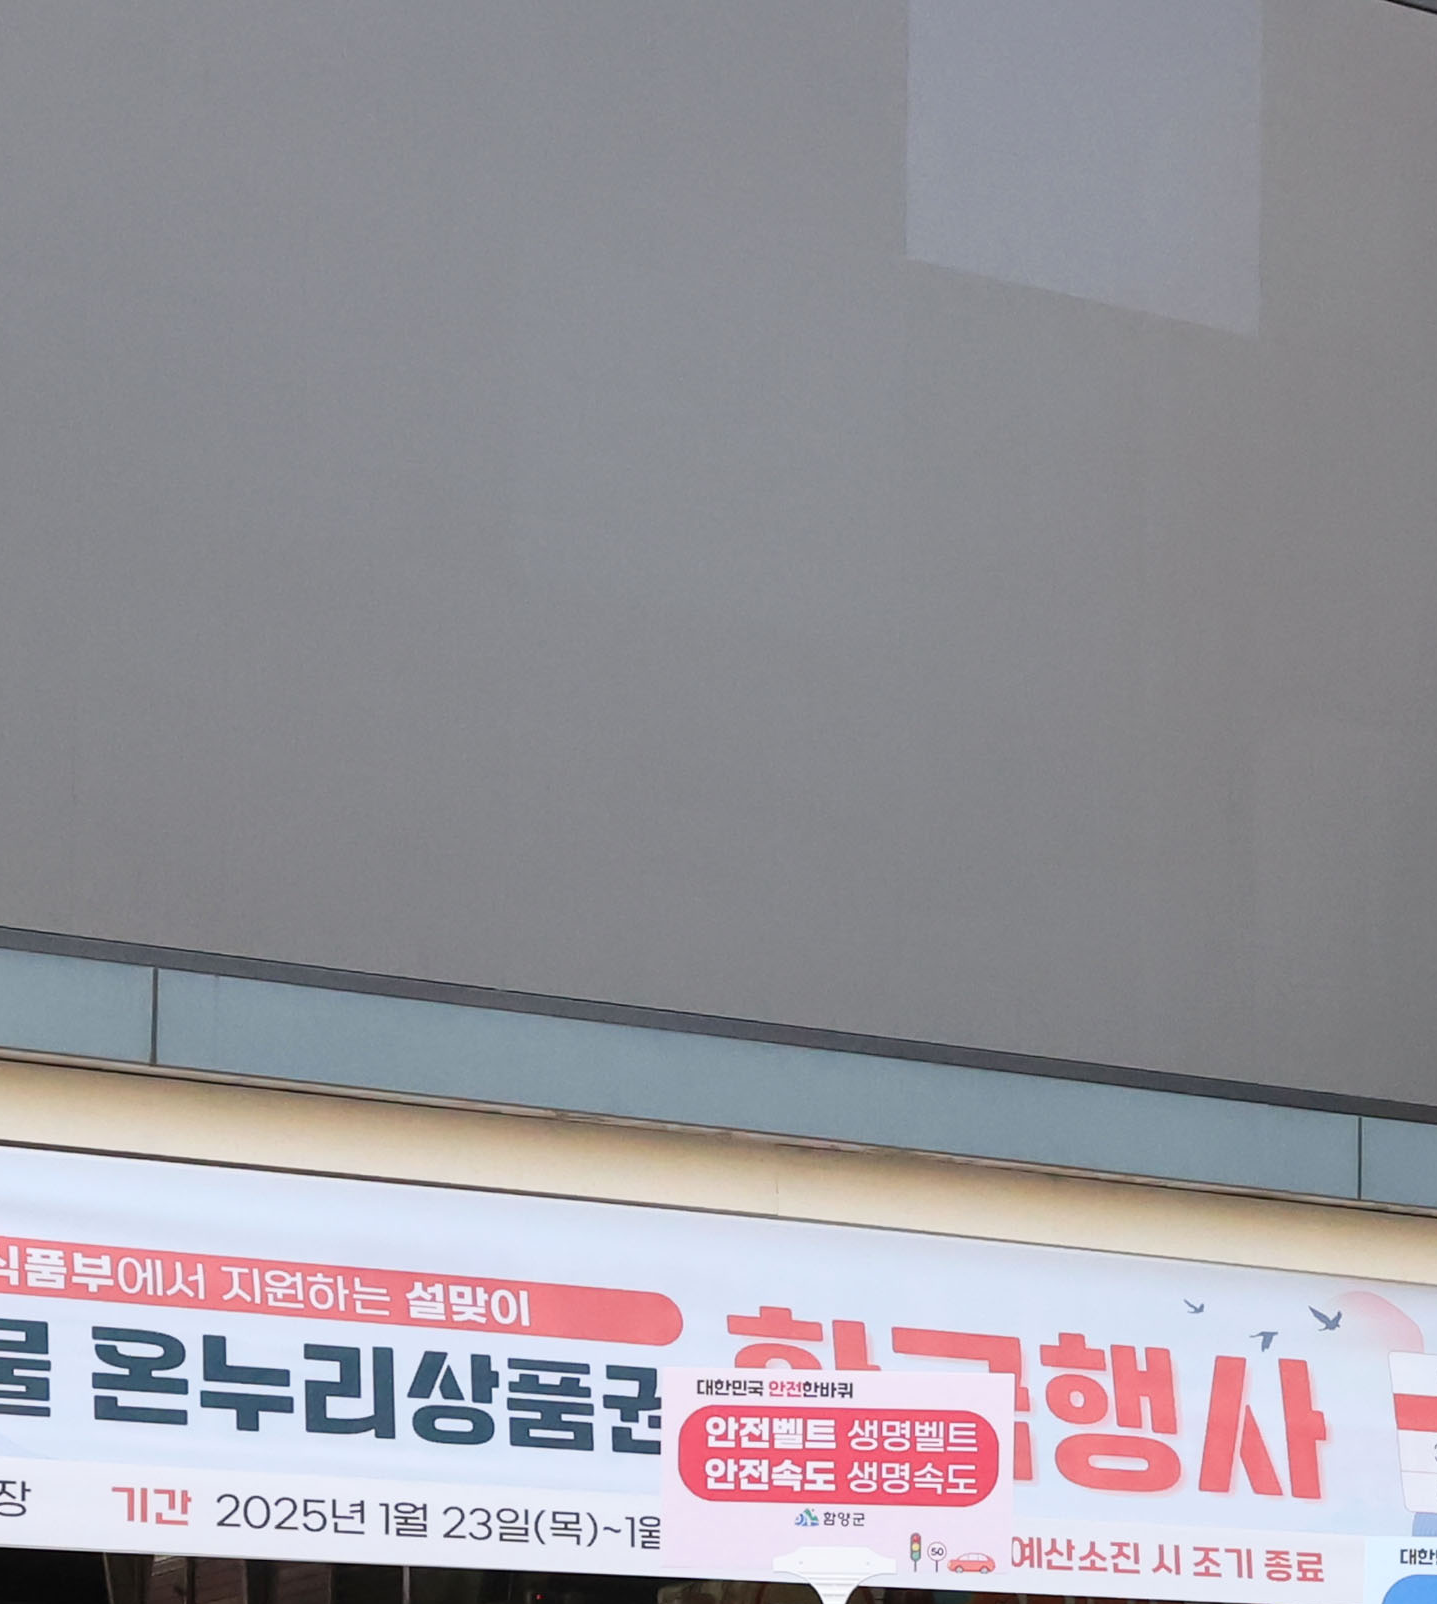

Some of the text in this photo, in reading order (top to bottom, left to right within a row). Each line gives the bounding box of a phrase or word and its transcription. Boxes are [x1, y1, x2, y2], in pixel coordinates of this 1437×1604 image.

[221, 1265, 391, 1317] 지원하는
[405, 1280, 532, 1327] 설맞이
[696, 1378, 854, 1400] 대한민국 안전한바퀴
[704, 1416, 978, 1454] 안전벨트 생명벨트
[704, 1458, 978, 1498] 안전속도 생명속도
[111, 1486, 194, 1528] 기간
[216, 1494, 367, 1536] 2025년
[380, 1502, 430, 1540] 1월
[823, 1509, 867, 1528] 함양군
[1011, 1534, 1326, 1584] 예산소진 시 조기 종료
